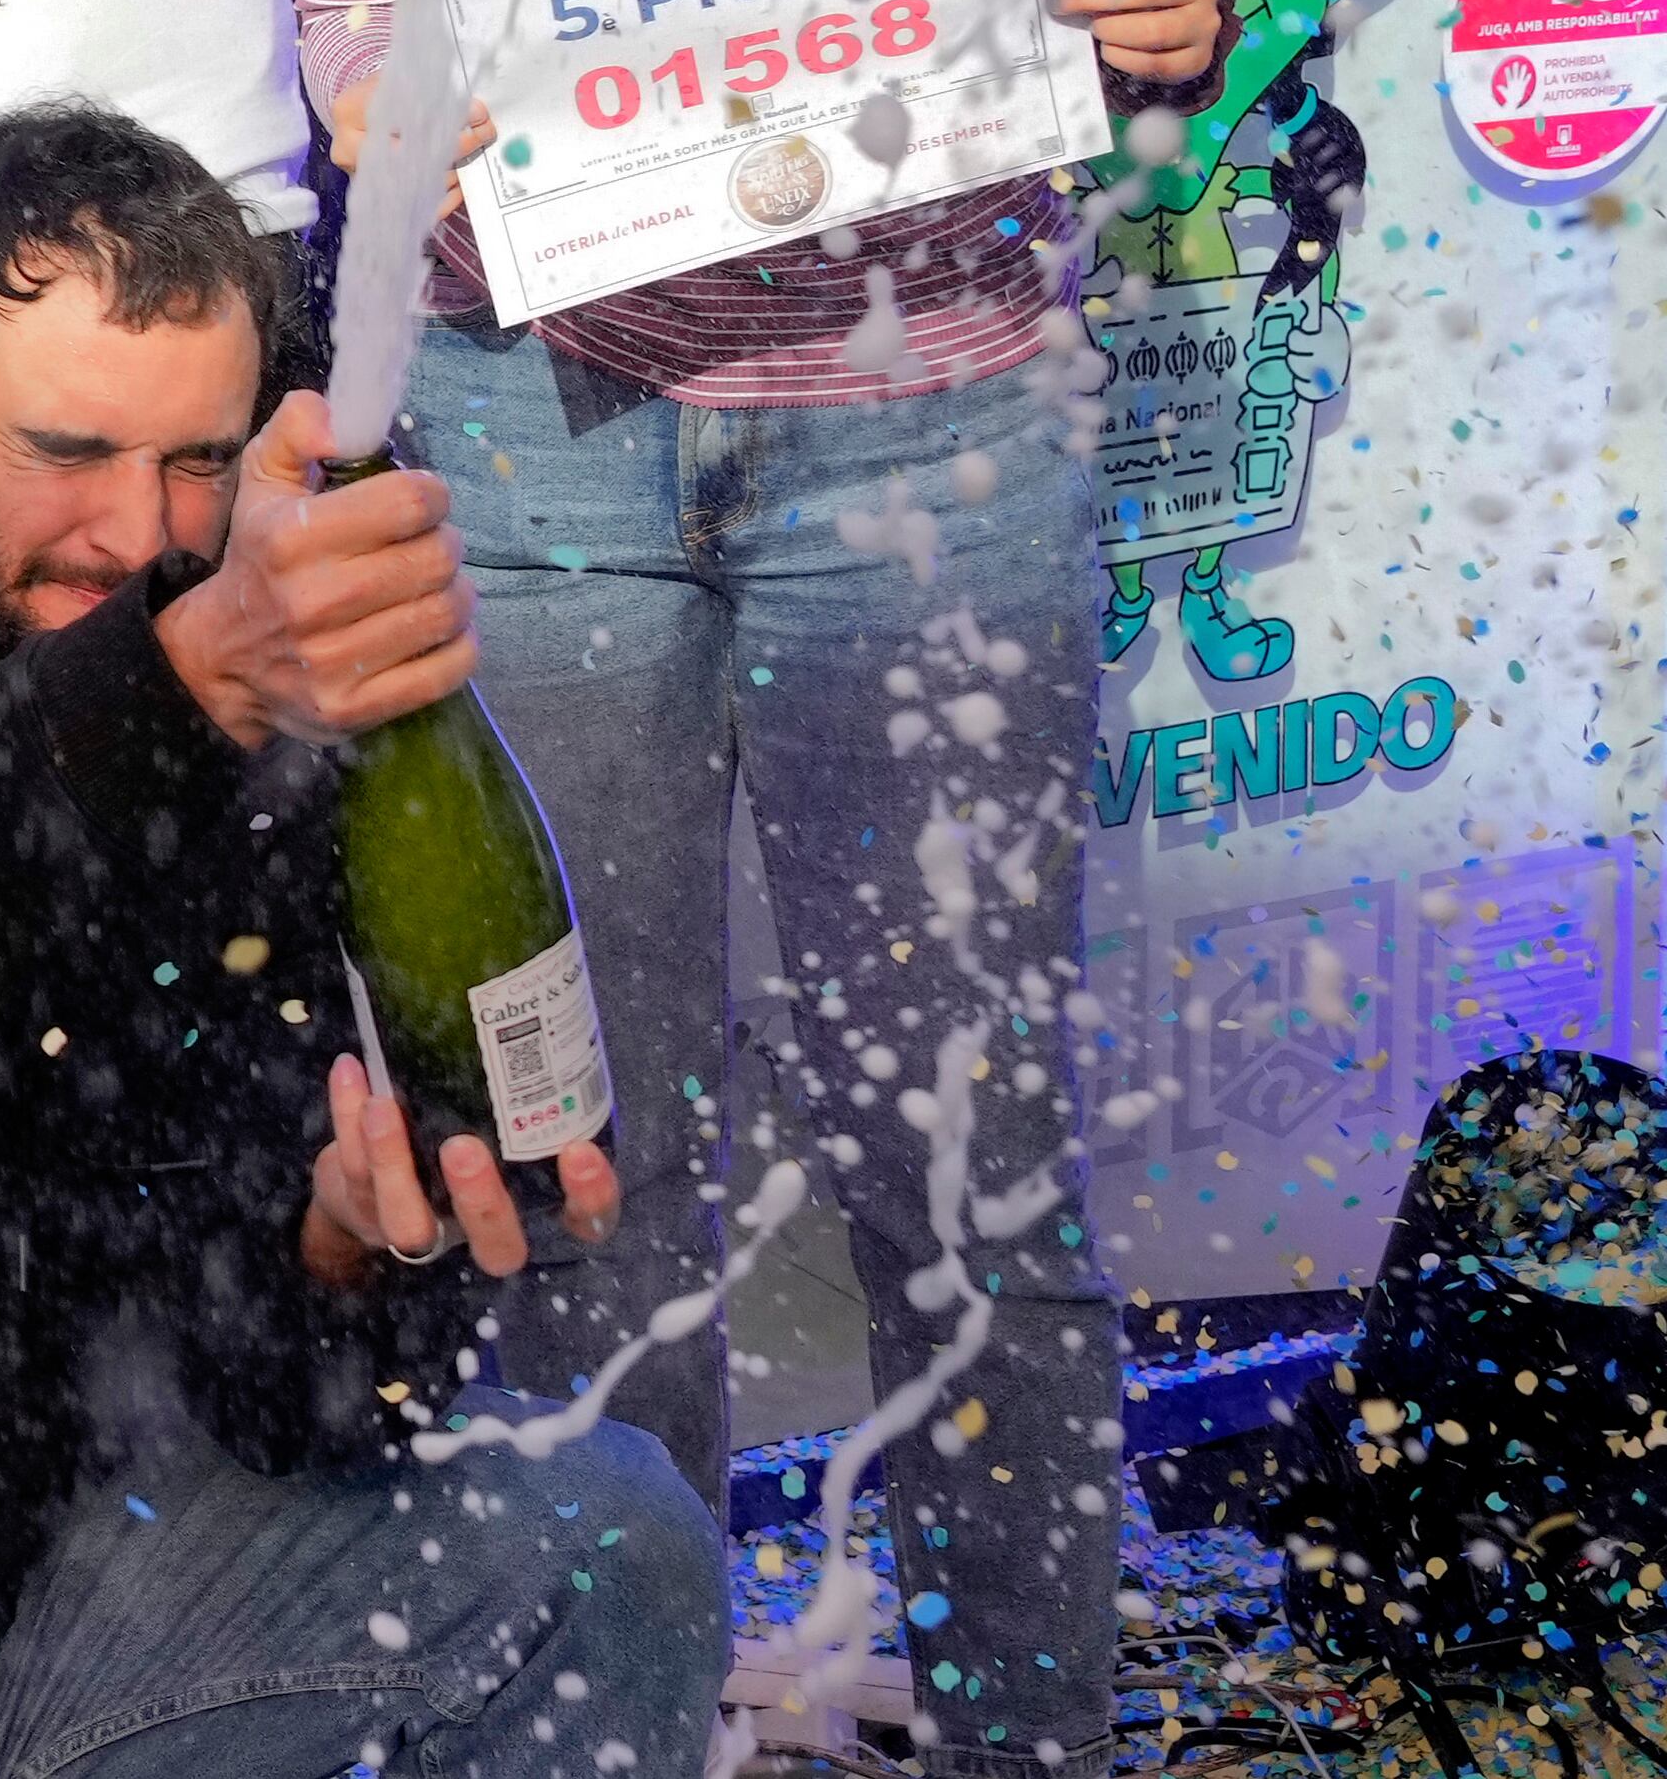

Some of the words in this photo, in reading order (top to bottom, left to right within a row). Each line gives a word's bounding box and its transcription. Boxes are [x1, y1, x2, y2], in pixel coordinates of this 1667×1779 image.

[1477, 23, 1512, 38] JUGA
[1515, 19, 1544, 34] AMB
[1546, 8, 1659, 31] RESPONSABILITAT
[1543, 73, 1560, 86] LA
[1562, 71, 1603, 85] VENDA
[1603, 69, 1612, 81] A
[1544, 55, 1607, 70] PROHIBIDA
[1543, 83, 1634, 103] AUTOPROHIBITS
[535, 231, 609, 263] LOTERIA
[611, 226, 629, 240] de
[631, 205, 695, 233] NADAL
[1125, 394, 1222, 431] Nacional
[480, 995, 541, 1026] Cabré
[546, 985, 561, 1003] &
